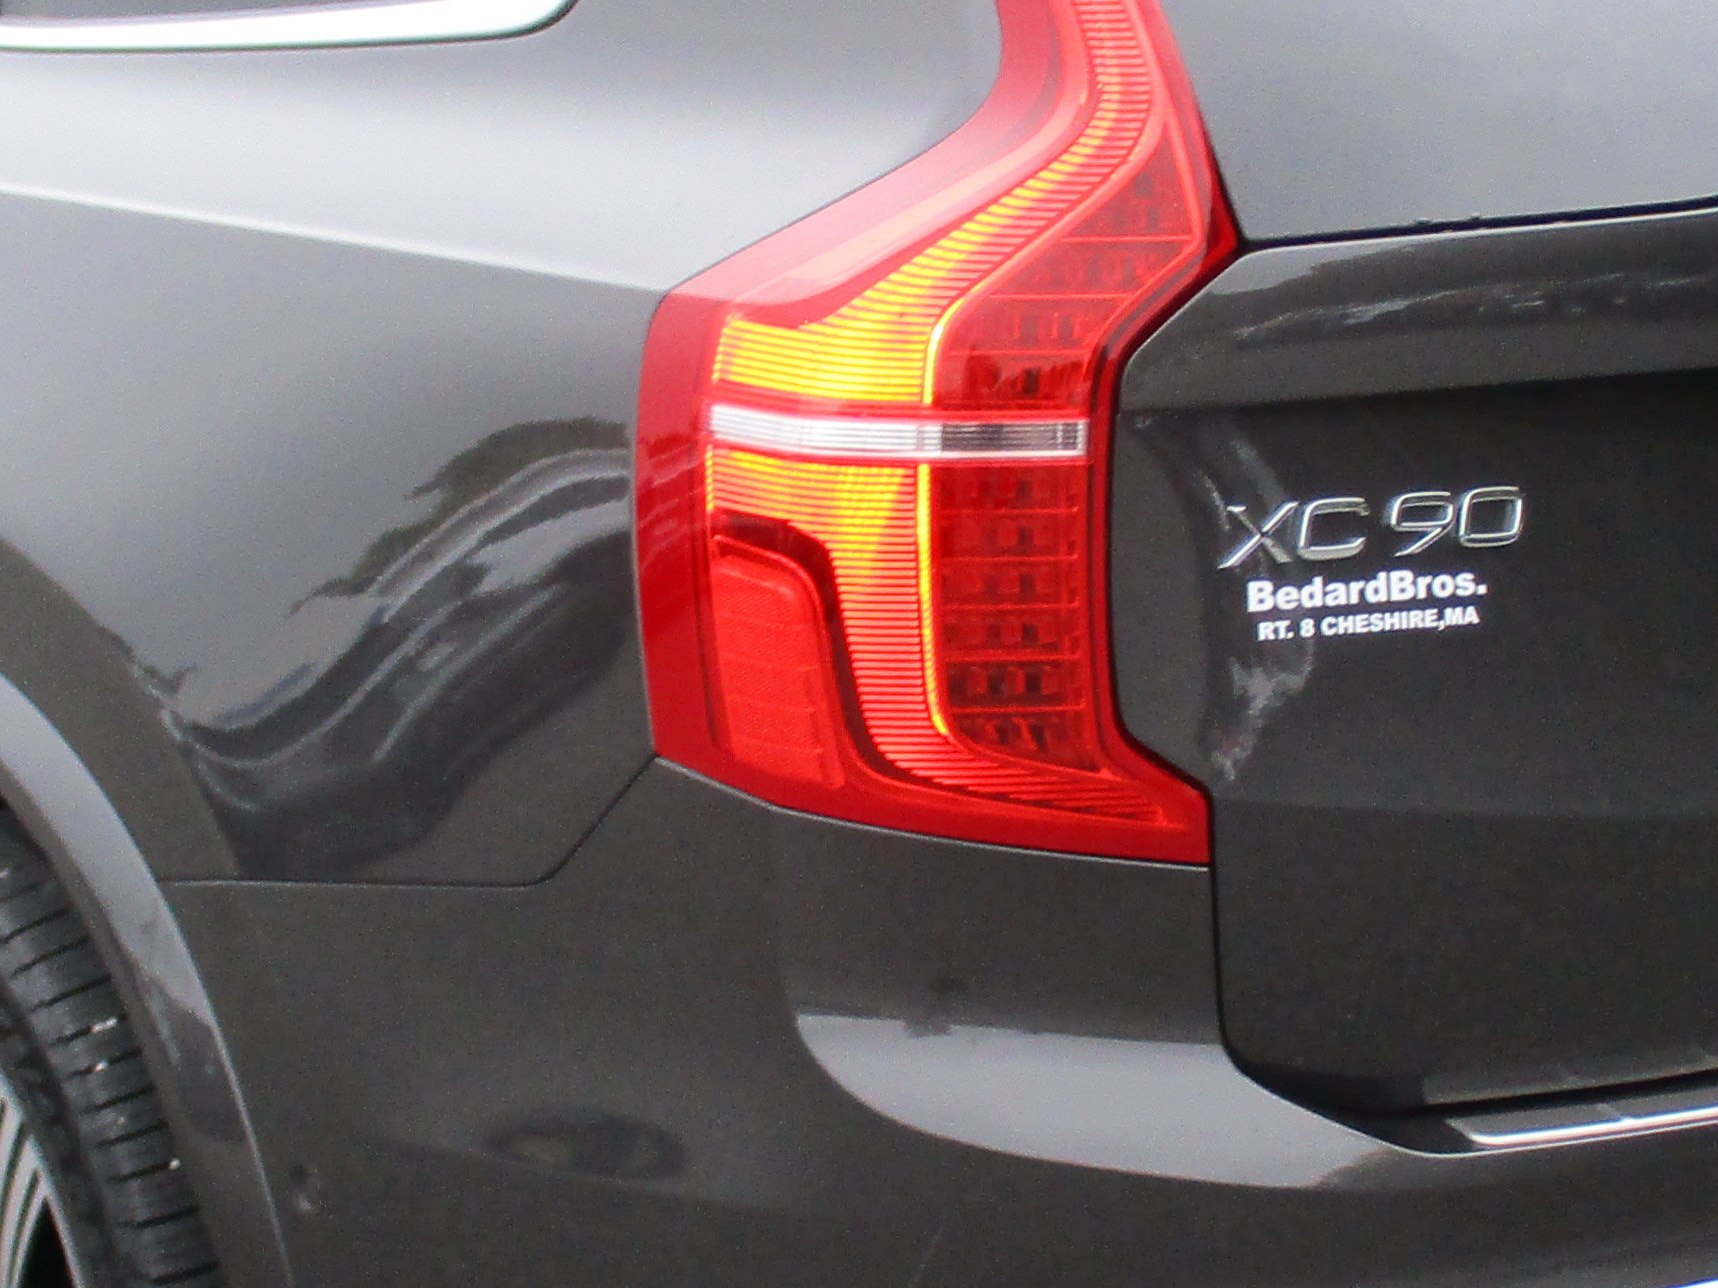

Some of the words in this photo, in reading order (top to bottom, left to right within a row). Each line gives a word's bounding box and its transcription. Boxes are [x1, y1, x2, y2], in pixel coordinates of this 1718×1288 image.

[1245, 568, 1489, 613] BedardBros.
[1256, 619, 1295, 641] RT.
[1299, 615, 1316, 638] 8
